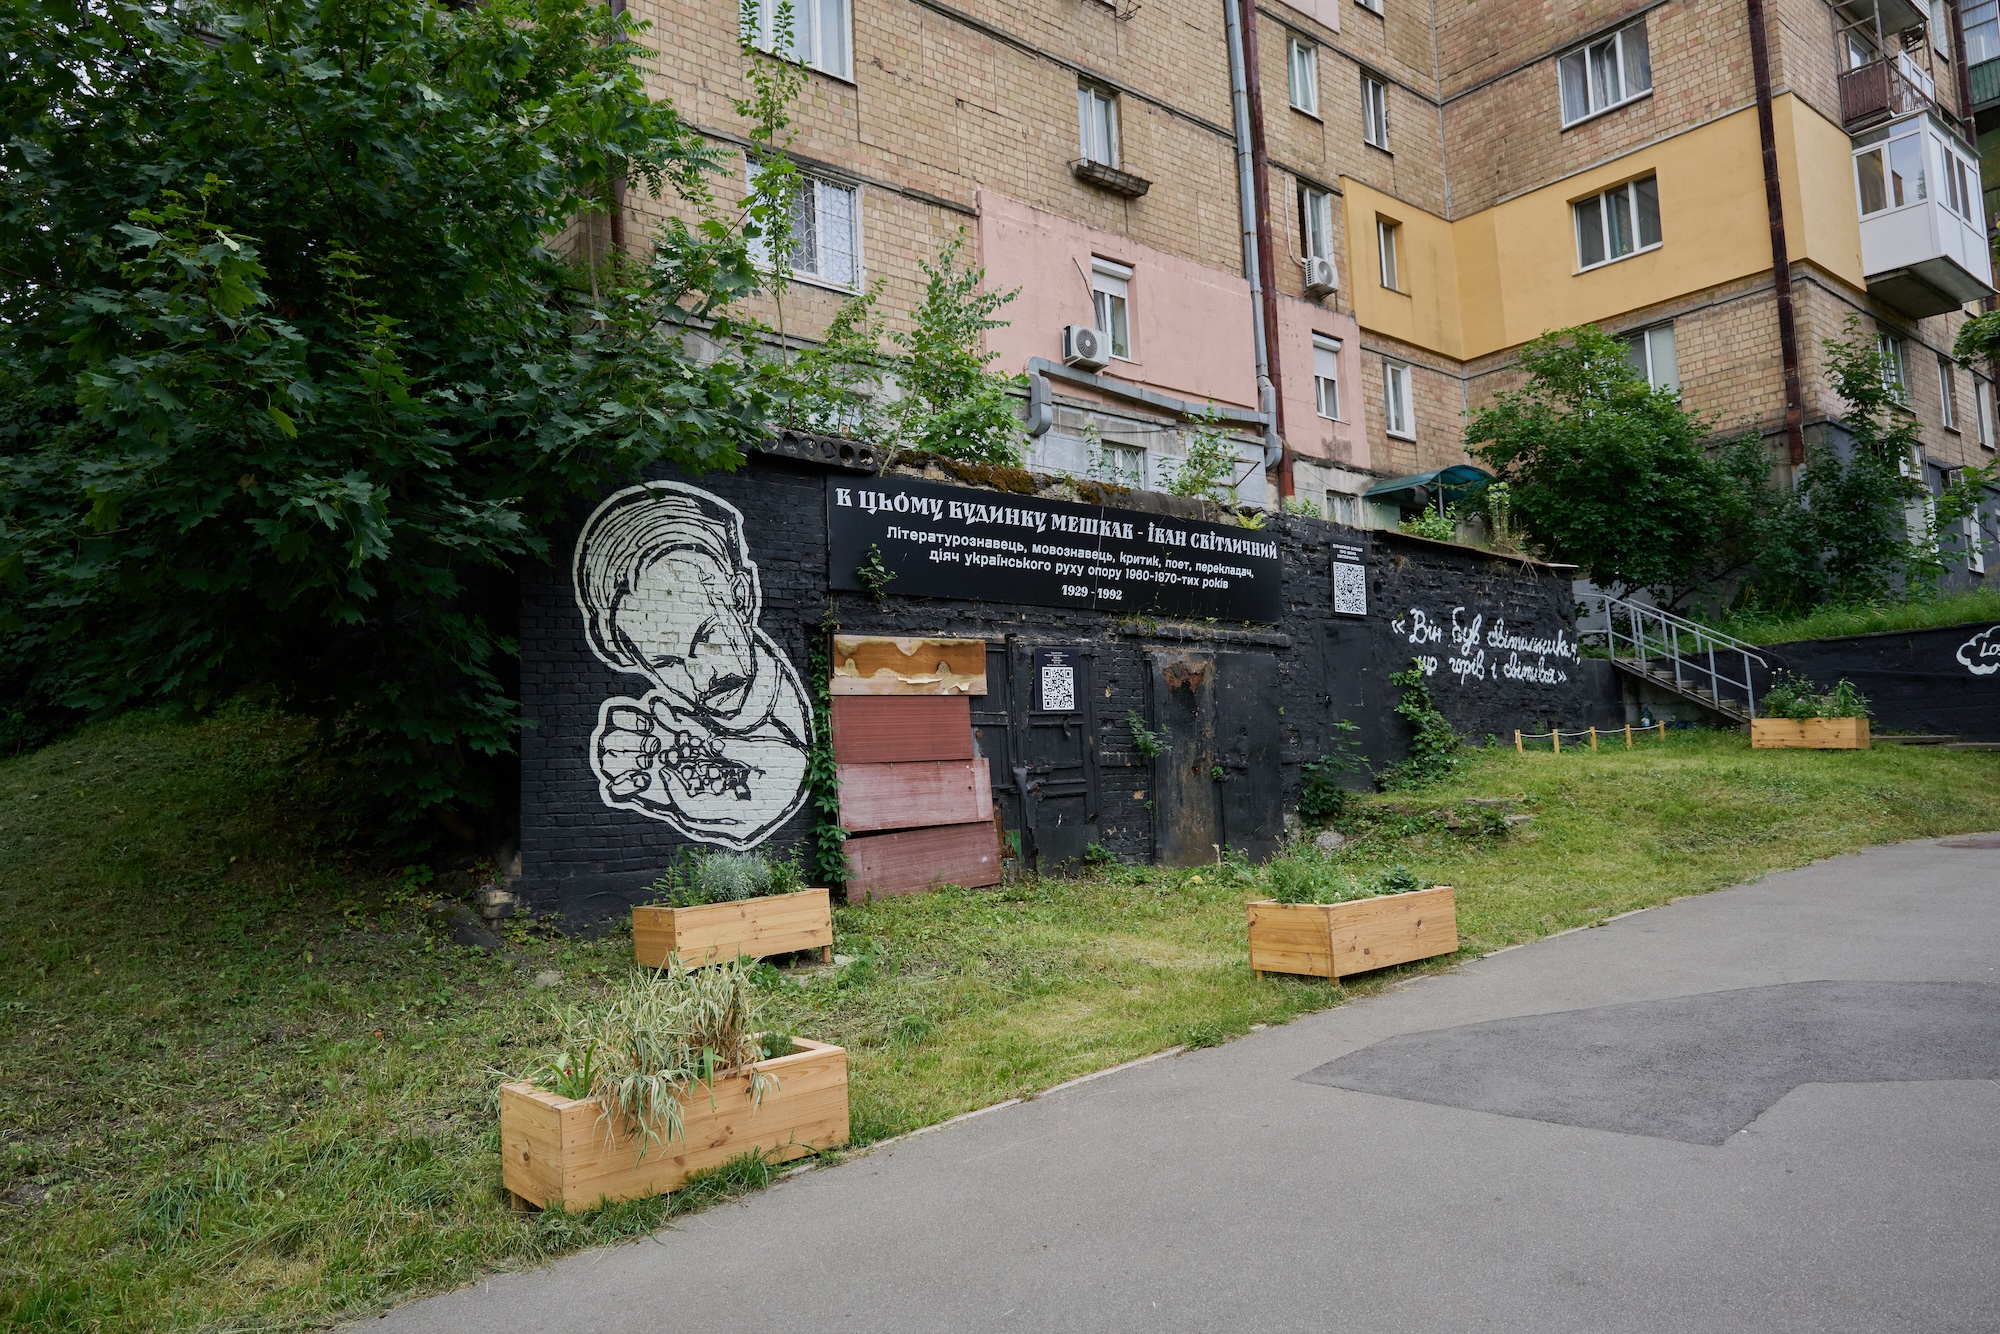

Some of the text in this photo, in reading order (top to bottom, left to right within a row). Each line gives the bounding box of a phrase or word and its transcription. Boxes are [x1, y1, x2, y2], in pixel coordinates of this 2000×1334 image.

[834, 487, 853, 507] В
[948, 500, 1048, 534] БУДИНКУ
[1050, 513, 1134, 540] МЕШКАВ
[1190, 530, 1279, 560] СВІТЛИЧНИЙ
[886, 525, 1255, 579] Літературознавець, мовознавець, критик, поет, перекладач,
[928, 550, 1230, 590] діяч українського руху опору 1960-1970-тих років
[1061, 584, 1089, 598] 1929
[1097, 587, 1123, 601] 1992
[1451, 606, 1483, 657] був
